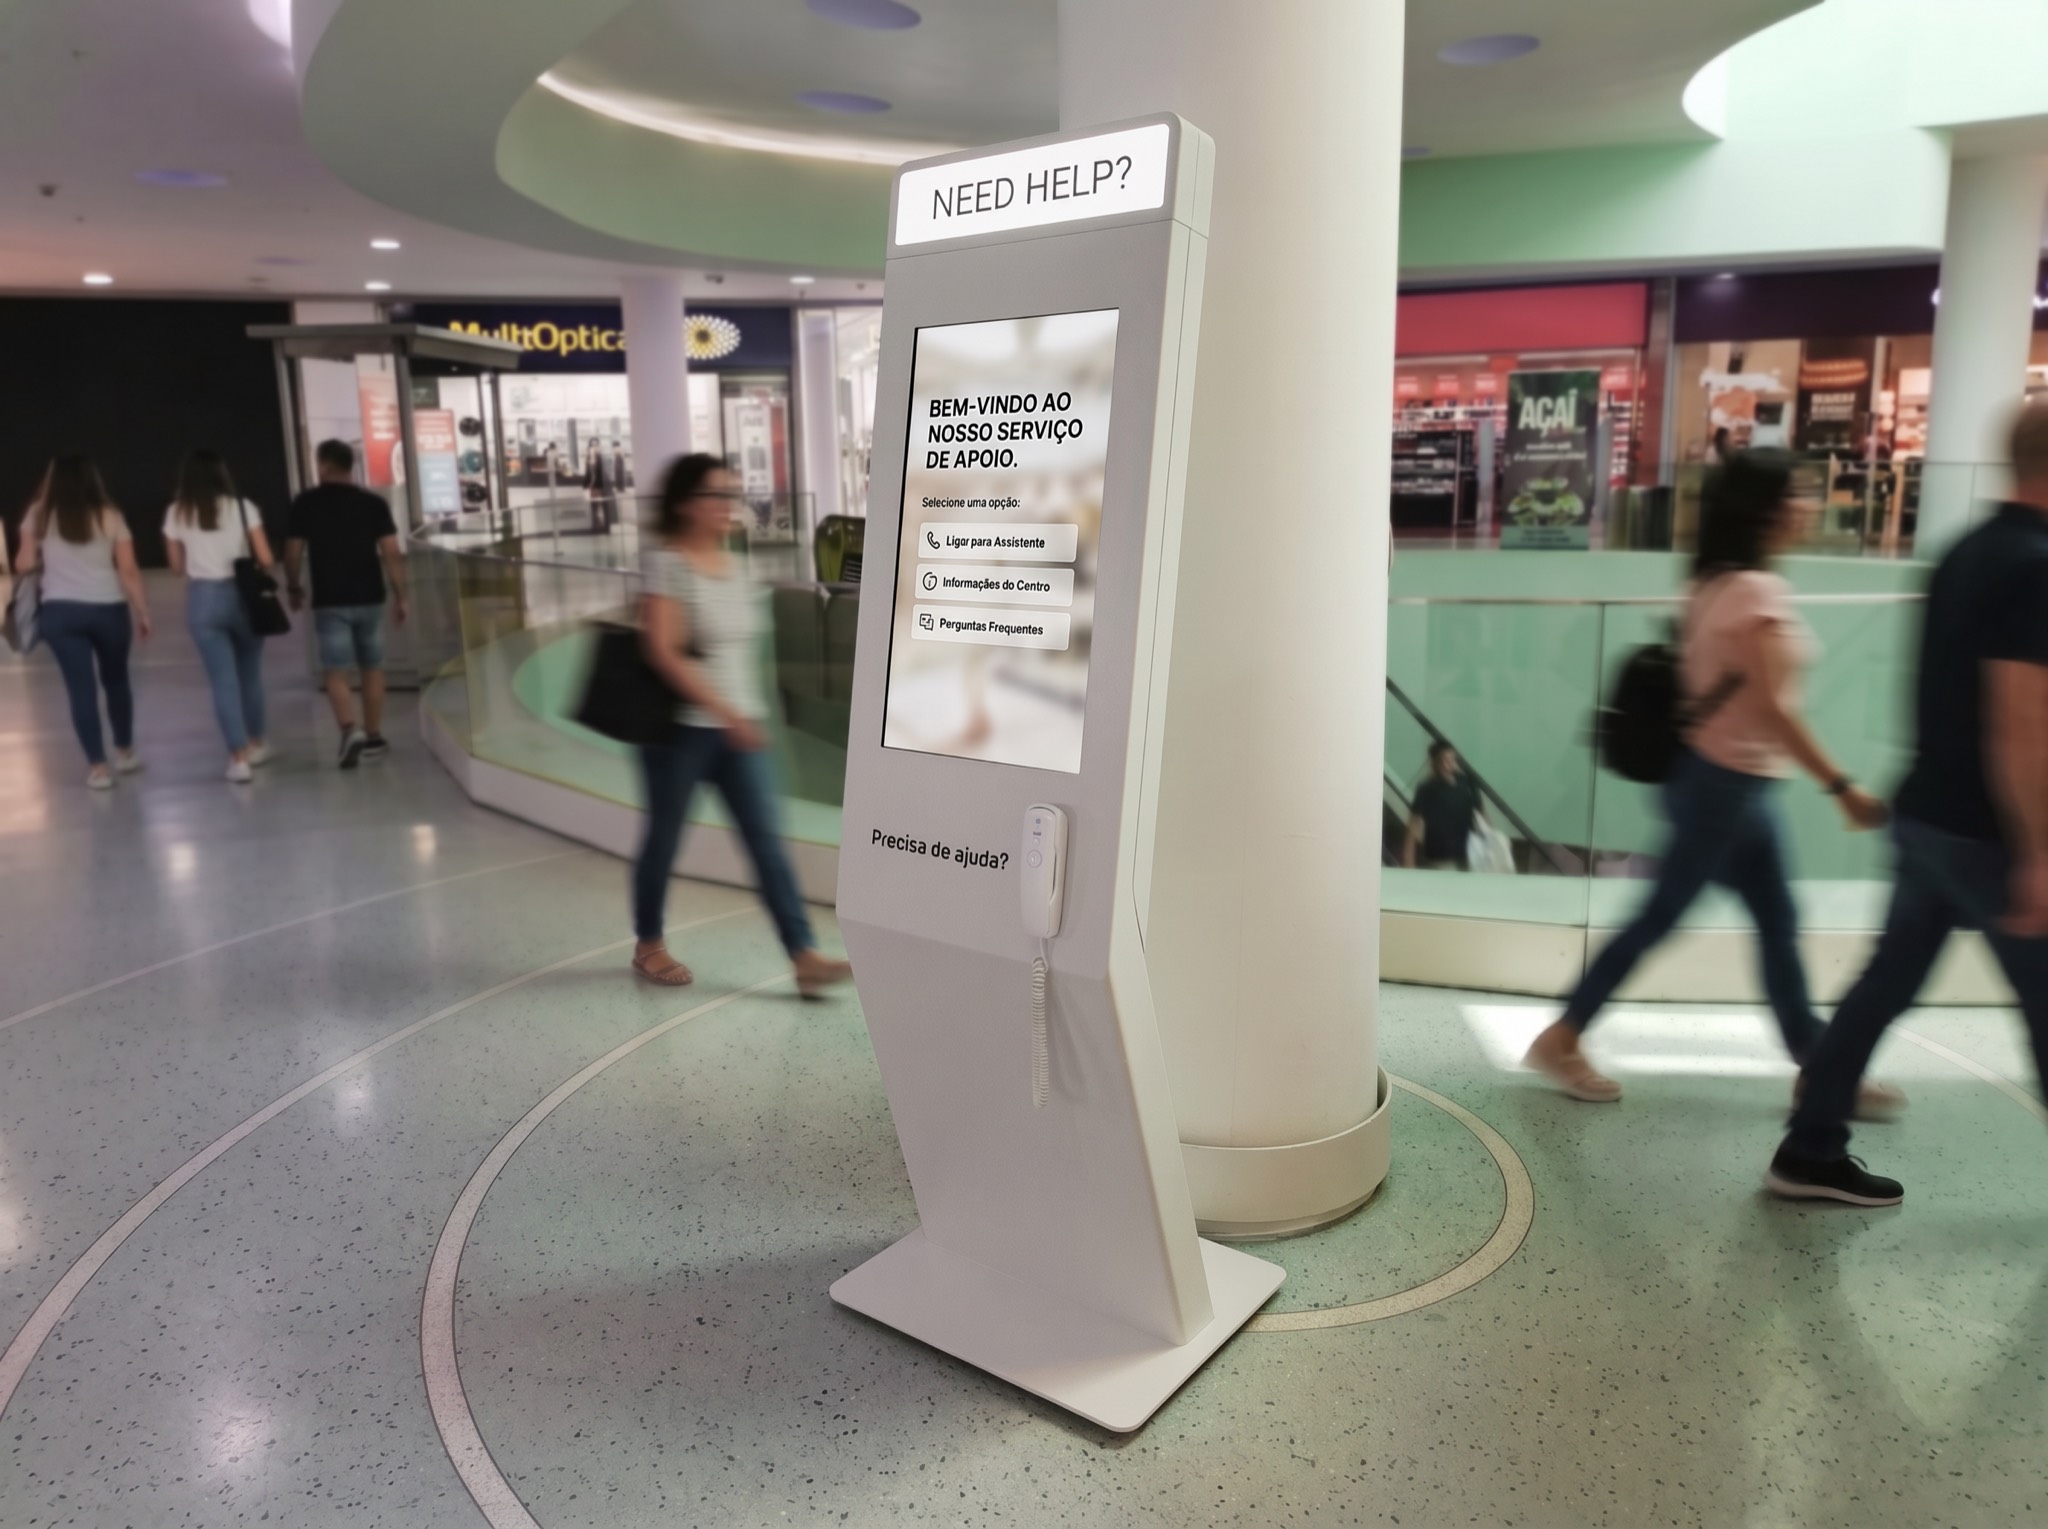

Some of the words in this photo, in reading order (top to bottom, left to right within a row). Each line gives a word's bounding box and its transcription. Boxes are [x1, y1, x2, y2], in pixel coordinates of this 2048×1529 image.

[933, 177, 1014, 219] NEED
[1026, 156, 1132, 204] HELP?
[929, 394, 1037, 417] BEM-VINDO
[1042, 392, 1072, 412] AO
[928, 423, 993, 443] NOSSO
[997, 419, 1083, 444] SERVIÇO
[926, 451, 950, 469] DE
[953, 449, 1018, 469] APOIO.
[922, 497, 965, 508] Selecione
[967, 499, 987, 508] uma
[988, 497, 1020, 510] opção:
[946, 535, 969, 549] Ligar
[971, 537, 992, 549] para
[994, 536, 1045, 549] Assistente
[1002, 579, 1015, 590] do
[1017, 580, 1050, 592] Centro
[939, 618, 986, 632] Perguntas
[989, 621, 1043, 636] Frequentes
[872, 829, 926, 855] Precisa
[931, 841, 951, 859] de
[954, 847, 1009, 870] ajuda?
